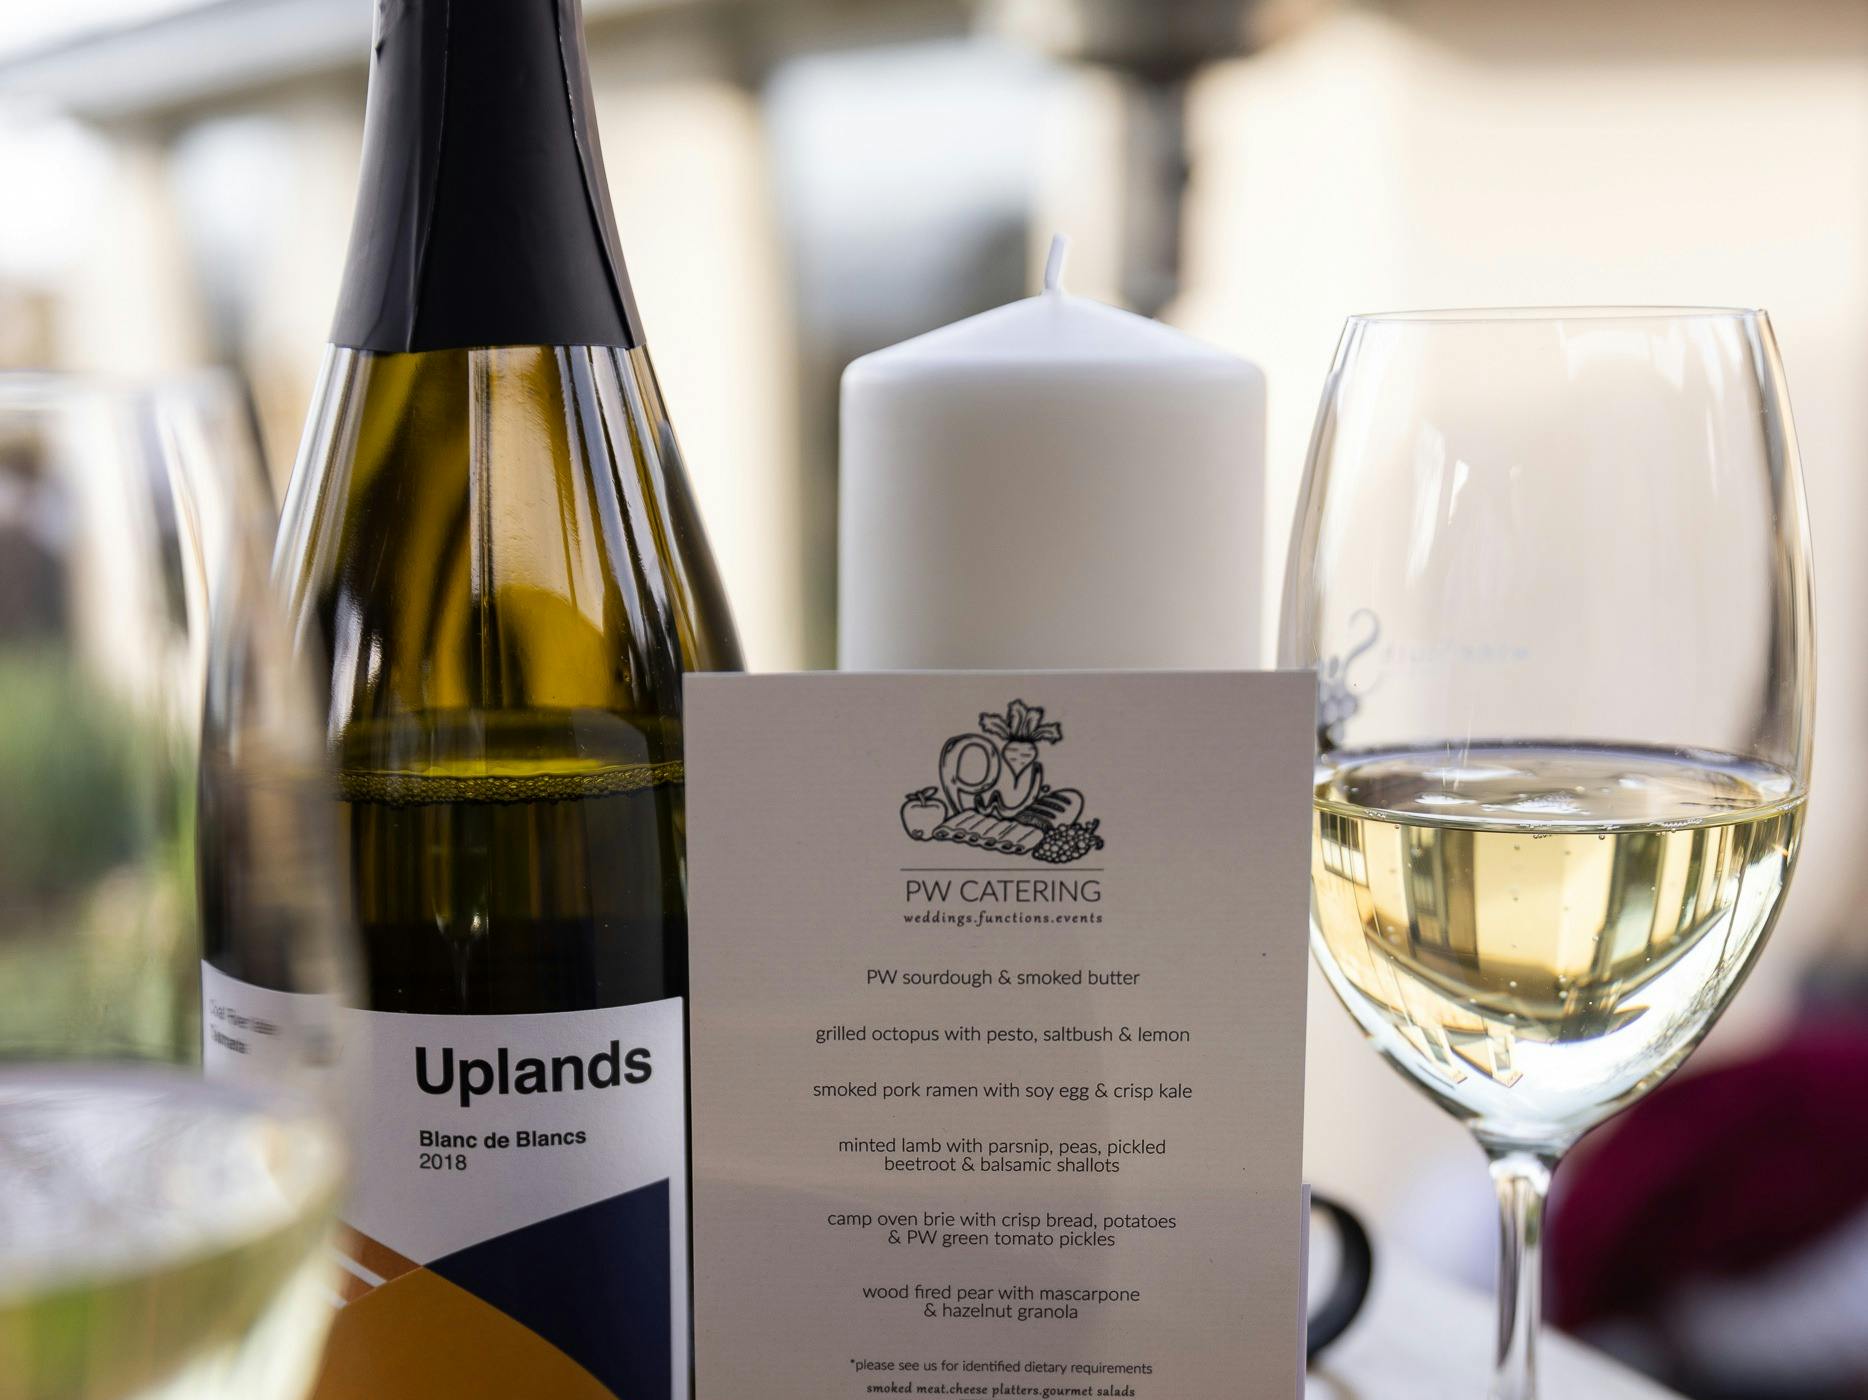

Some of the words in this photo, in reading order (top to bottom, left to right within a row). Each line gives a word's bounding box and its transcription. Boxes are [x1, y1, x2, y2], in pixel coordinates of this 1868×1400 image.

[905, 879, 953, 903] PW
[959, 879, 1102, 903] CATERING
[903, 909, 1103, 928] weddings.functions.events
[866, 968, 898, 985] PW
[902, 968, 993, 989] sourdough
[997, 969, 1013, 986] &
[1016, 968, 1083, 986] smoked
[1087, 969, 1141, 986] butter
[815, 1024, 867, 1045] grilled
[871, 1026, 940, 1045] octopus
[943, 1025, 982, 1042] with
[986, 1026, 1038, 1045] pesto,
[1041, 1025, 1113, 1043] saltbush
[1118, 1025, 1133, 1043] &
[1137, 1026, 1191, 1043] lemon
[415, 1040, 651, 1108] Uplands
[812, 1081, 879, 1098] smoked
[881, 1081, 921, 1101] pork
[925, 1084, 979, 1098] ramen
[982, 1081, 1020, 1099] with
[1024, 1085, 1055, 1102] soy
[1058, 1086, 1090, 1102] egg
[1094, 1082, 1109, 1099] &
[1113, 1082, 1154, 1102] crisp
[1159, 1082, 1193, 1099] kale
[420, 1130, 477, 1148] Blanc
[484, 1132, 510, 1149] de
[516, 1130, 586, 1148] Blancs
[838, 1136, 896, 1153] minted
[901, 1136, 942, 1153] lamb
[945, 1136, 983, 1154] with
[988, 1138, 1054, 1157] parsnip,
[1058, 1142, 1102, 1157] peas,
[1107, 1138, 1166, 1157] pickled
[420, 1153, 467, 1171] 2018
[884, 1155, 957, 1174] beetroot
[961, 1156, 977, 1172] &
[980, 1155, 1053, 1173] balsamic
[1056, 1156, 1121, 1173] shallots
[827, 1213, 873, 1231] camp
[877, 1214, 918, 1227] oven
[923, 1210, 956, 1227] brie
[959, 1210, 997, 1228] with
[1001, 1211, 1041, 1231] crisp
[1046, 1211, 1098, 1231] bread,
[1103, 1213, 1177, 1231] potatoes
[887, 1229, 902, 1247] &
[907, 1229, 938, 1245] PW
[941, 1233, 989, 1249] green
[993, 1231, 1054, 1247] tomato
[1059, 1230, 1116, 1249] pickles
[862, 1283, 910, 1300] wood
[913, 1283, 952, 1300] fired
[957, 1287, 995, 1303] pear
[997, 1284, 1035, 1301] with
[1039, 1287, 1141, 1303] mascarpone
[923, 1302, 938, 1318] &
[942, 1302, 1013, 1319] hazelnut
[1016, 1303, 1079, 1322] granola
[897, 1361, 920, 1372] see
[923, 1361, 938, 1372] us
[940, 1359, 960, 1372] for
[962, 1359, 1022, 1373] identified
[1023, 1360, 1068, 1376] dietary
[1070, 1361, 1153, 1376] requirements
[866, 1380, 913, 1394] smoked
[1096, 1383, 1137, 1398] salads
